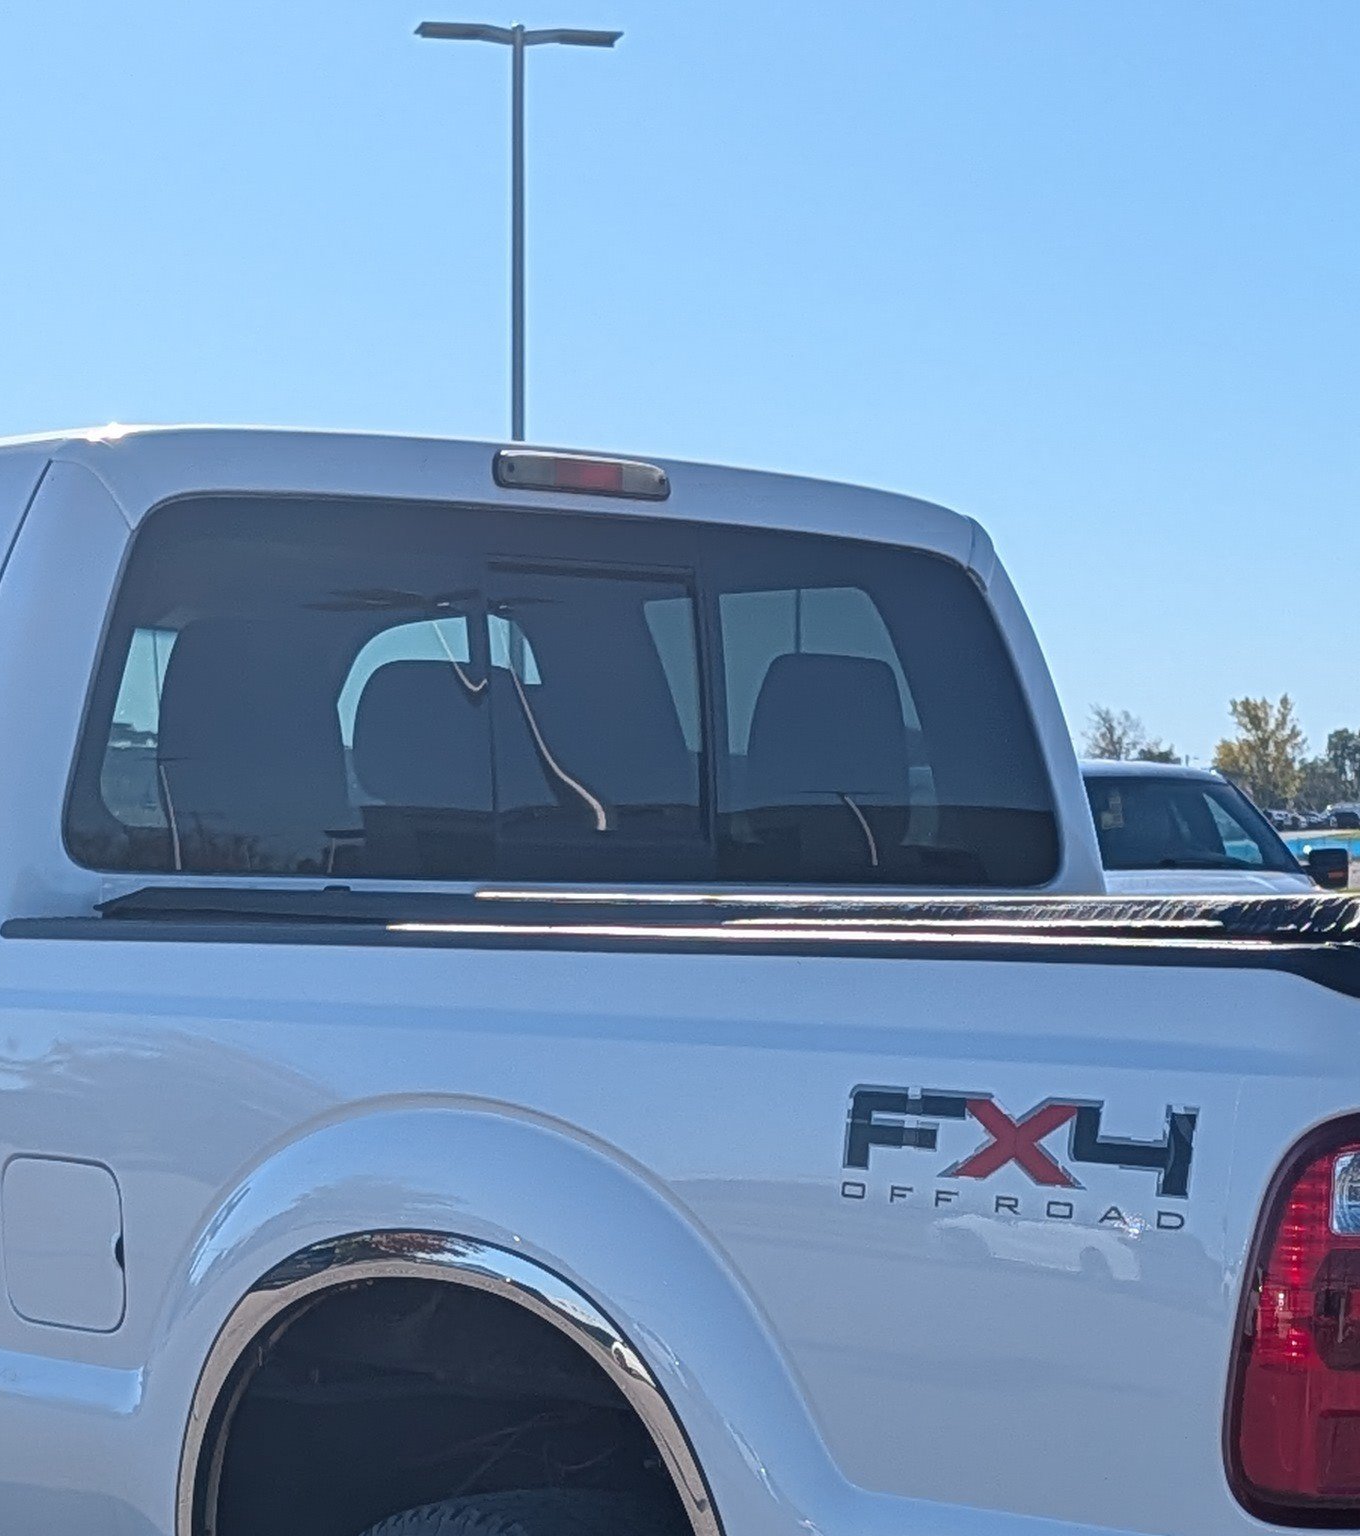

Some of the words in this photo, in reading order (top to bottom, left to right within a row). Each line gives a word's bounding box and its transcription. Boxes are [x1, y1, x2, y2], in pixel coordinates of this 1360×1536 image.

[843, 1083, 1200, 1199] FX4
[841, 1181, 959, 1208] OFF
[995, 1195, 1186, 1230] ROAD
